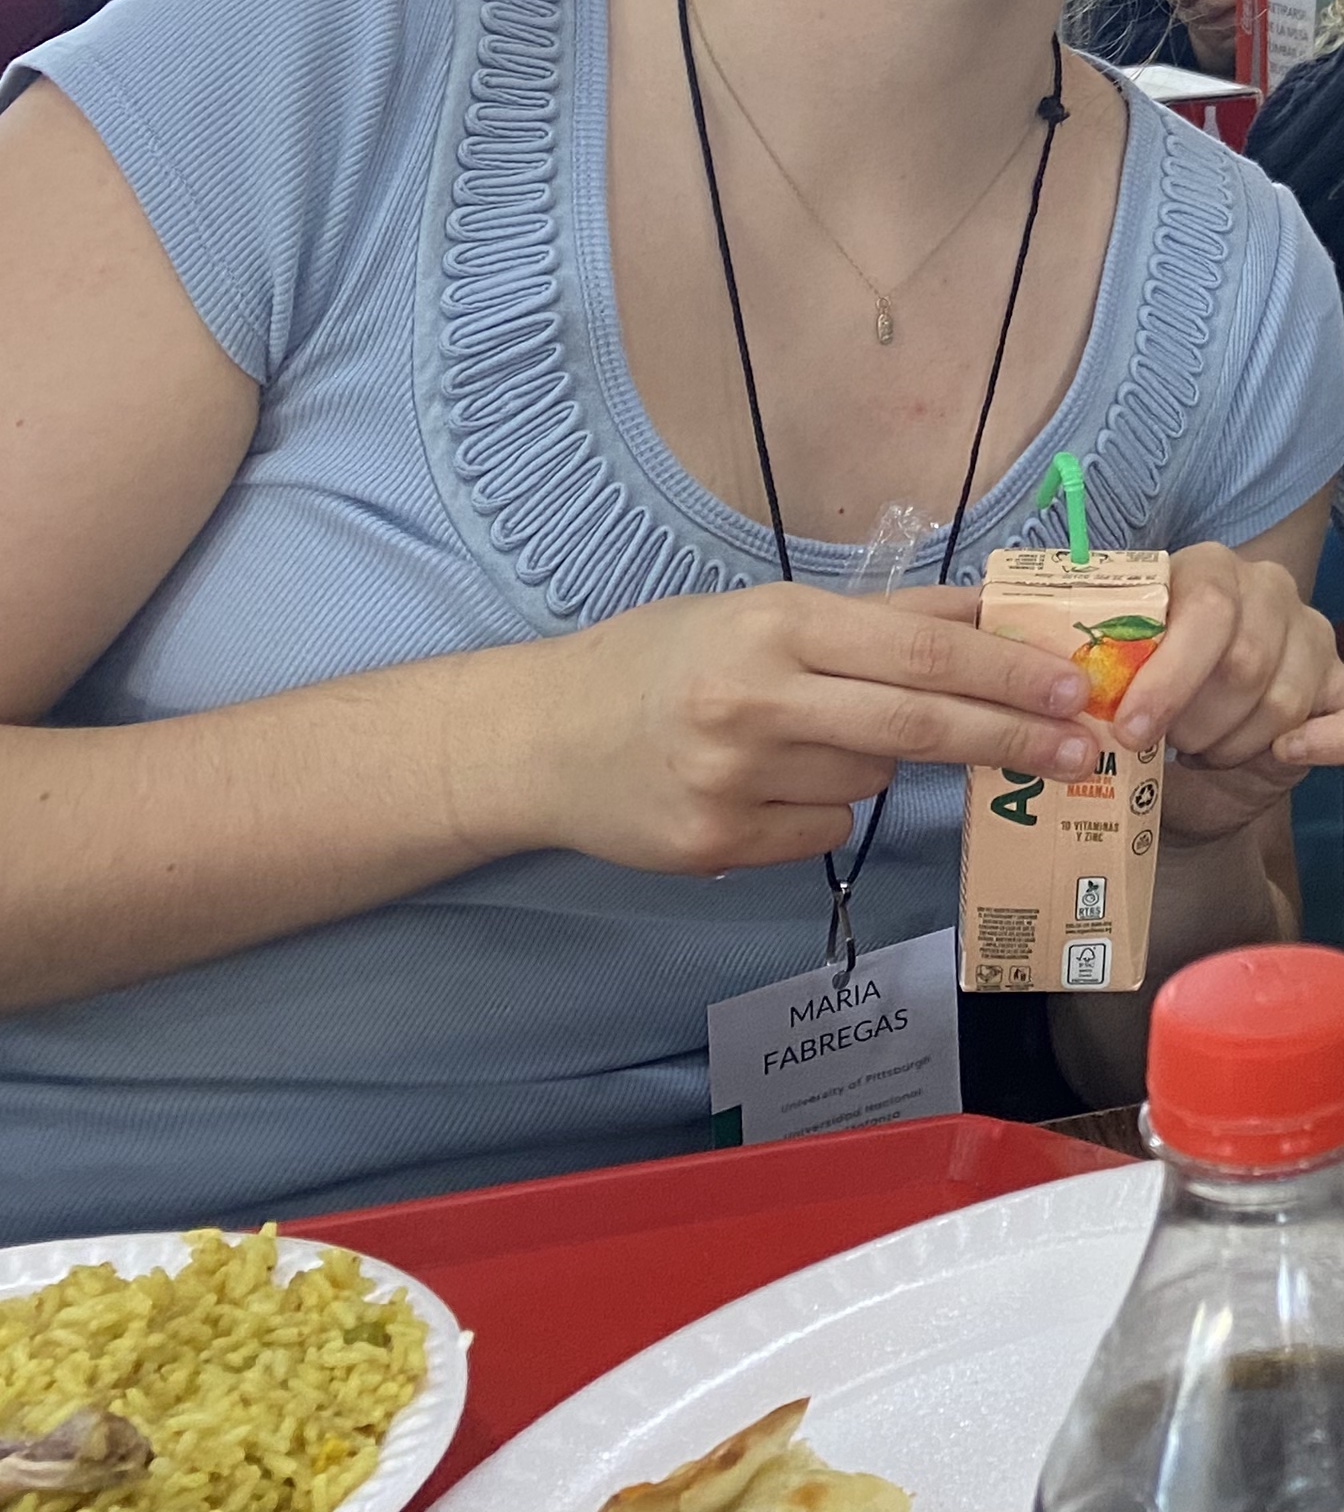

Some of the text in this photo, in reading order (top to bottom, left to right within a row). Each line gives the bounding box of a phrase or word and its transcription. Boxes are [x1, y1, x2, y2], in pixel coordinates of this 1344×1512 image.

[1066, 784, 1116, 800] NARANJA
[790, 979, 881, 1029] MARIA
[763, 1008, 909, 1076] FABREGAS
[865, 1054, 932, 1084] Pittsburgh
